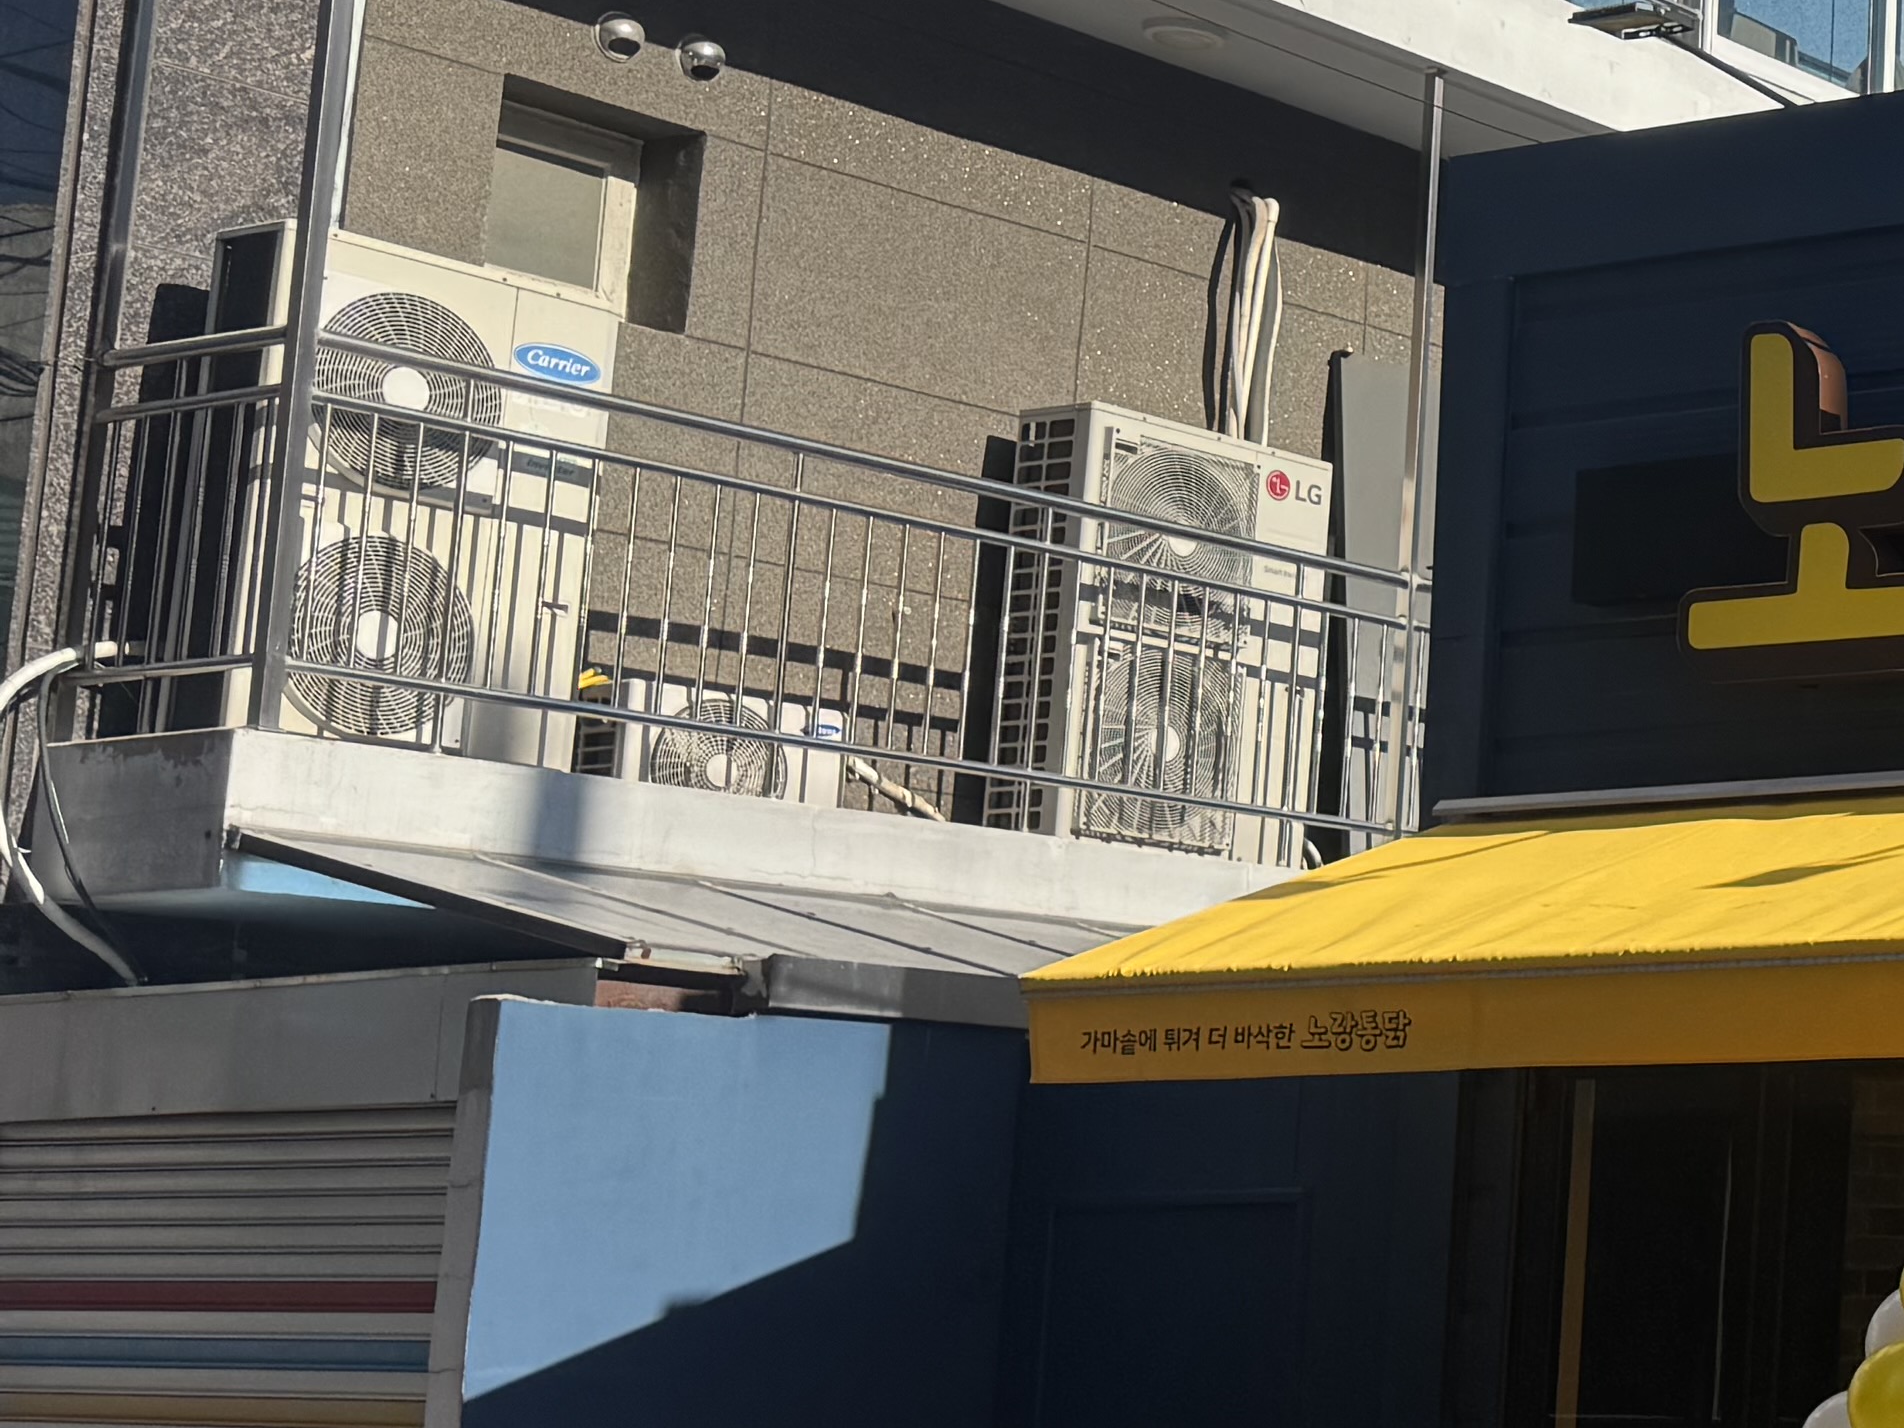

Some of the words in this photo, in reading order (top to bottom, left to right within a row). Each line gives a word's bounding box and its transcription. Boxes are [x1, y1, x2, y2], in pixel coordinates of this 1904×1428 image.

[526, 348, 591, 378] Carrier
[1294, 479, 1323, 506] LG
[1080, 1027, 1157, 1056] 가마솥에
[1163, 1026, 1201, 1052] 튀겨
[1208, 1026, 1227, 1051] 더
[1233, 1023, 1296, 1050] 바삭한
[1300, 1009, 1412, 1052] 노랑통닭
